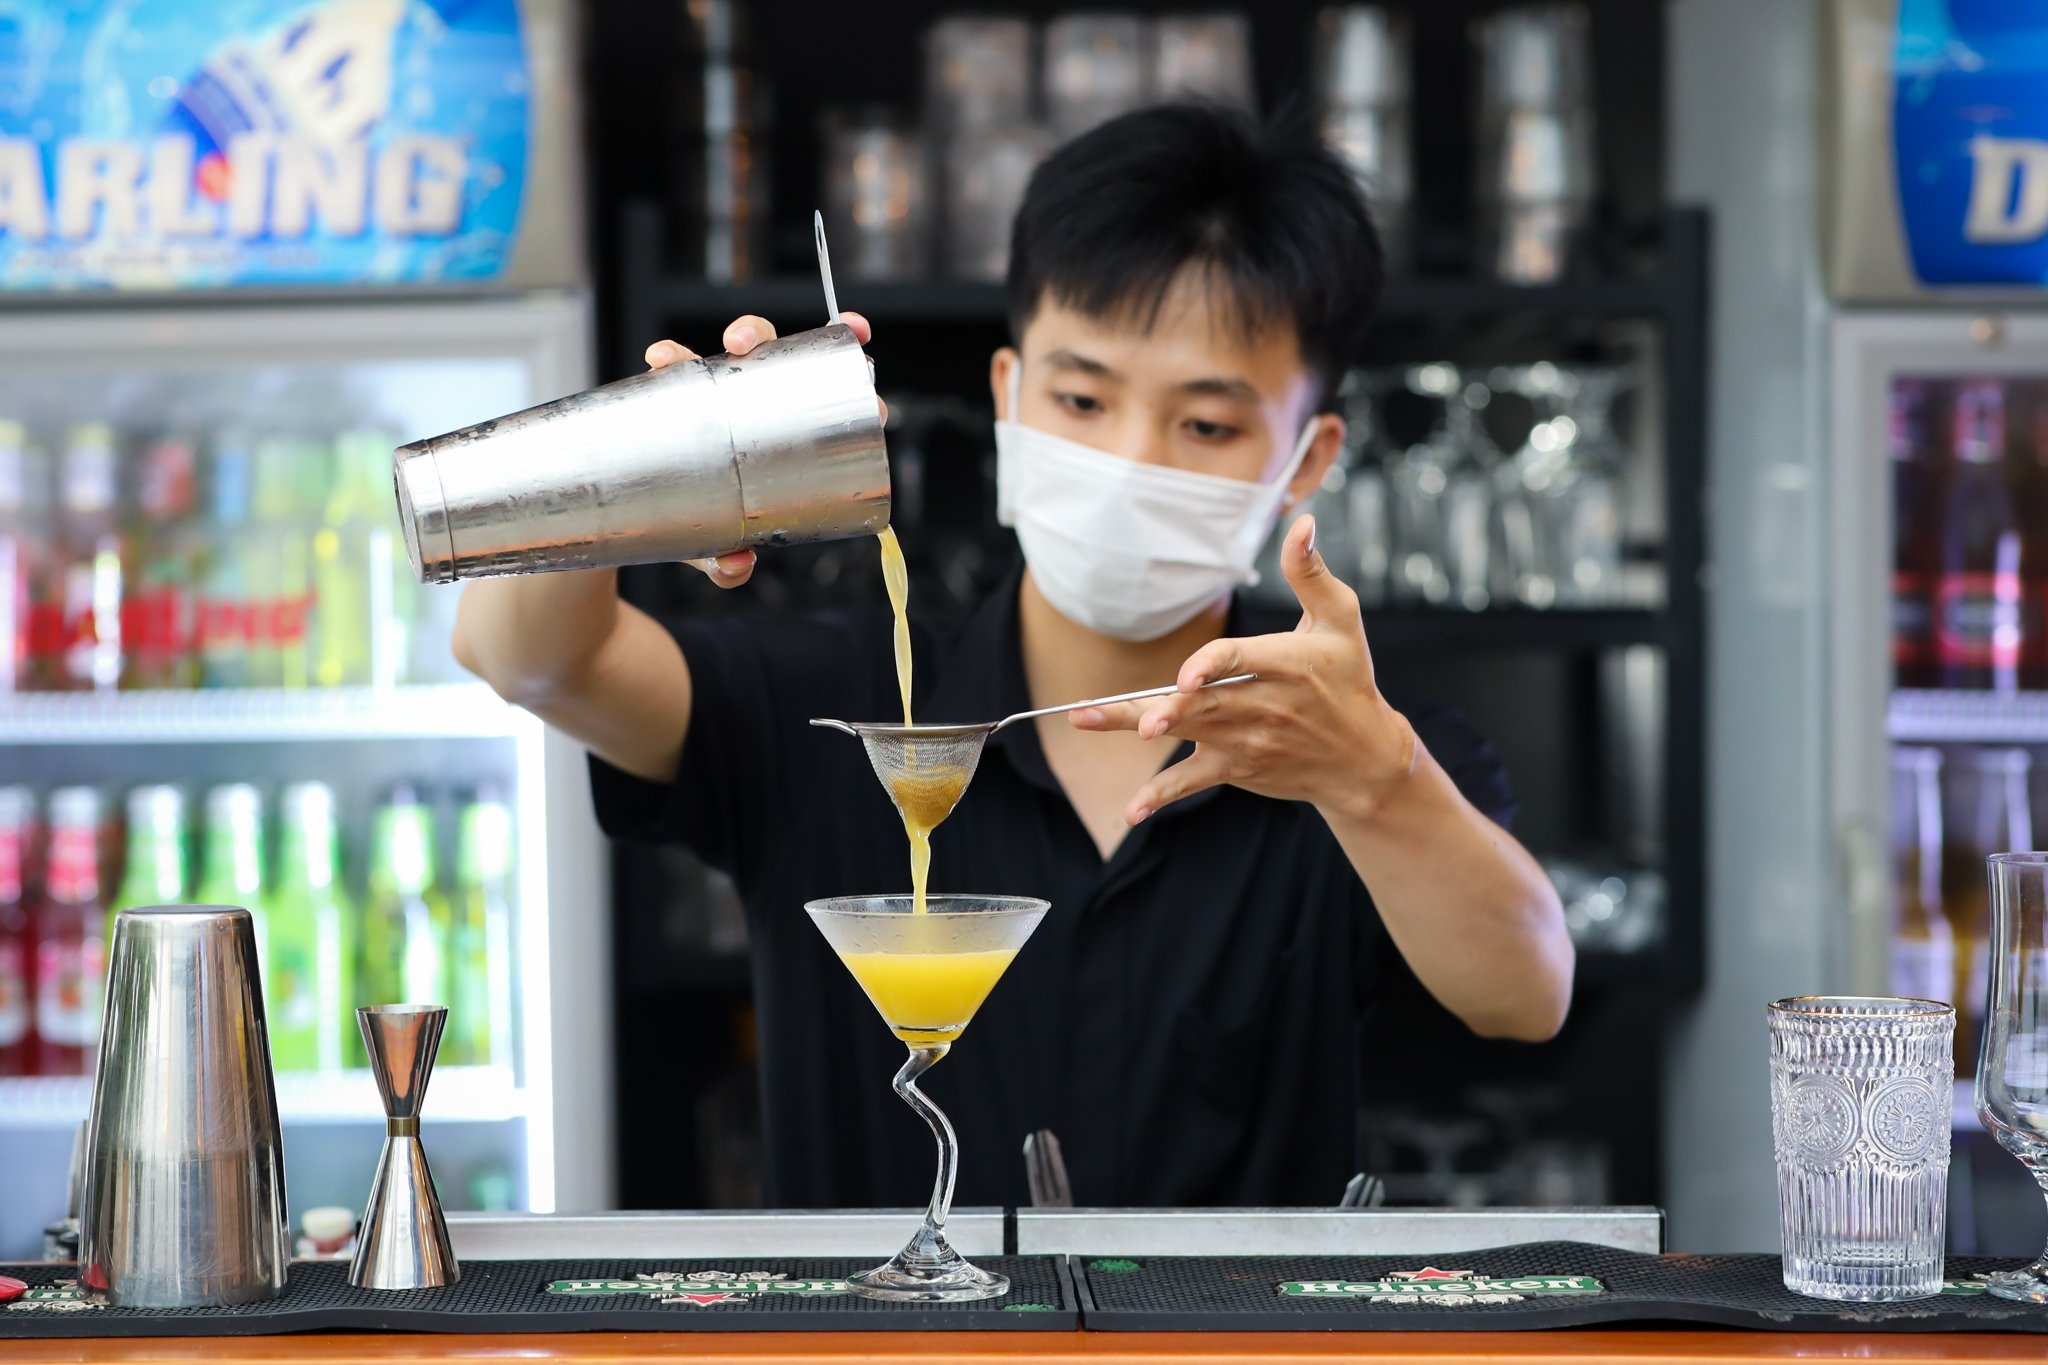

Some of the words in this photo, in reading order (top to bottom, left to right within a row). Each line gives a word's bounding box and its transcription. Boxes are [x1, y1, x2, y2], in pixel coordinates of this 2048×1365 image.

[1963, 136, 2048, 244] D
[569, 1281, 848, 1291] Heineken
[1299, 1278, 1583, 1292] Heineken
